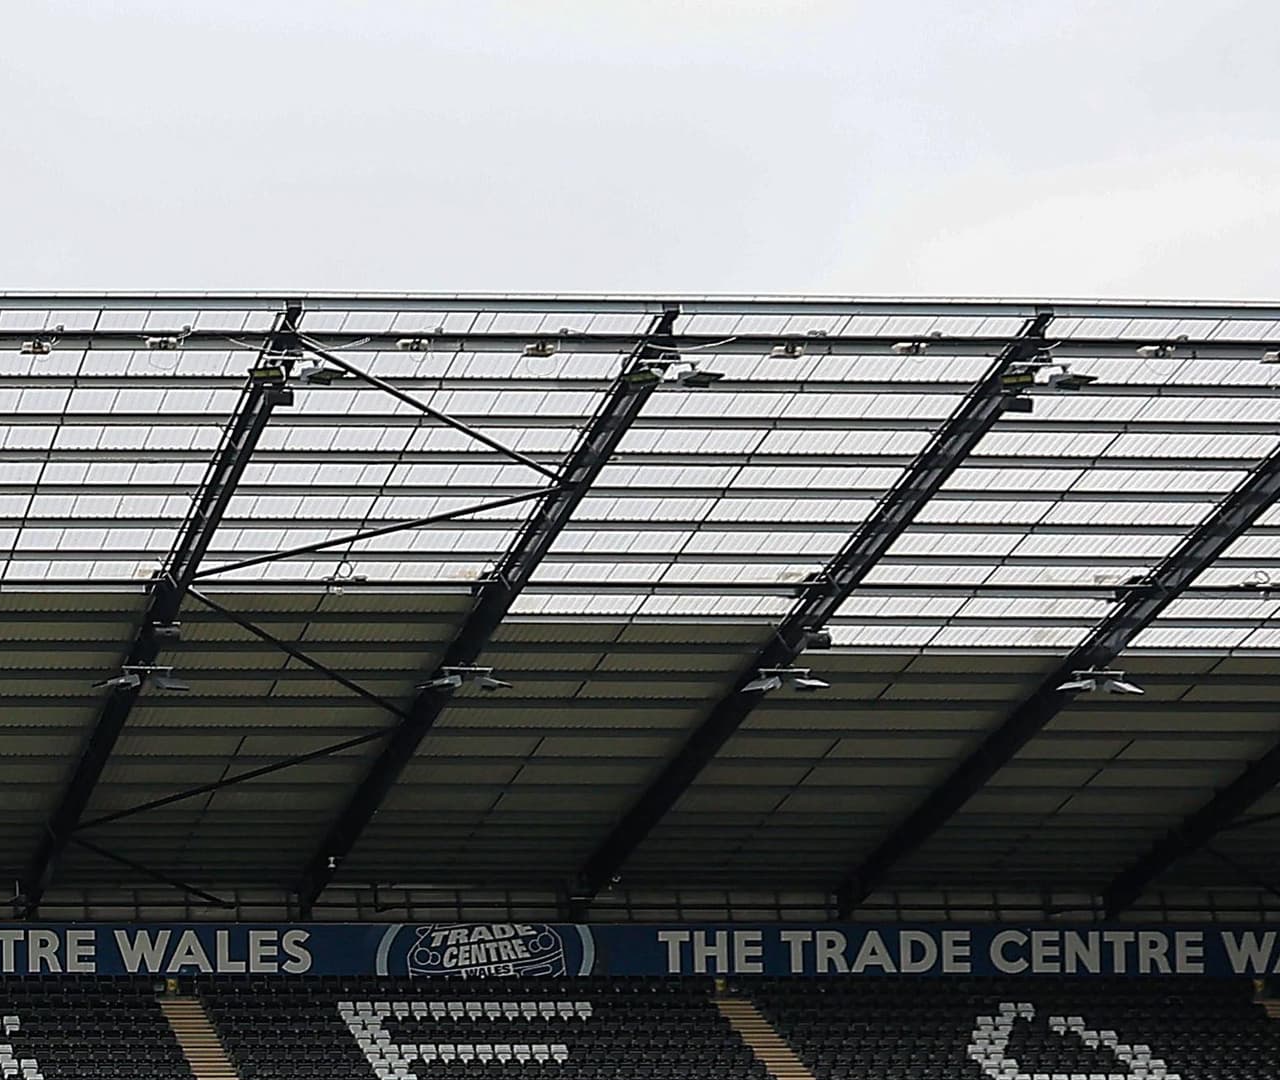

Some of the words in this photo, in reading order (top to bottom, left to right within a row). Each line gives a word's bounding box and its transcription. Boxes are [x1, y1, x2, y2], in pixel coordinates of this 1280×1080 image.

[114, 929, 311, 973] WALES
[431, 924, 538, 947] TRADE
[443, 939, 531, 968] CENTRE
[658, 931, 763, 973] THE
[781, 931, 970, 973] TRADE
[990, 930, 1203, 973] CENTRE
